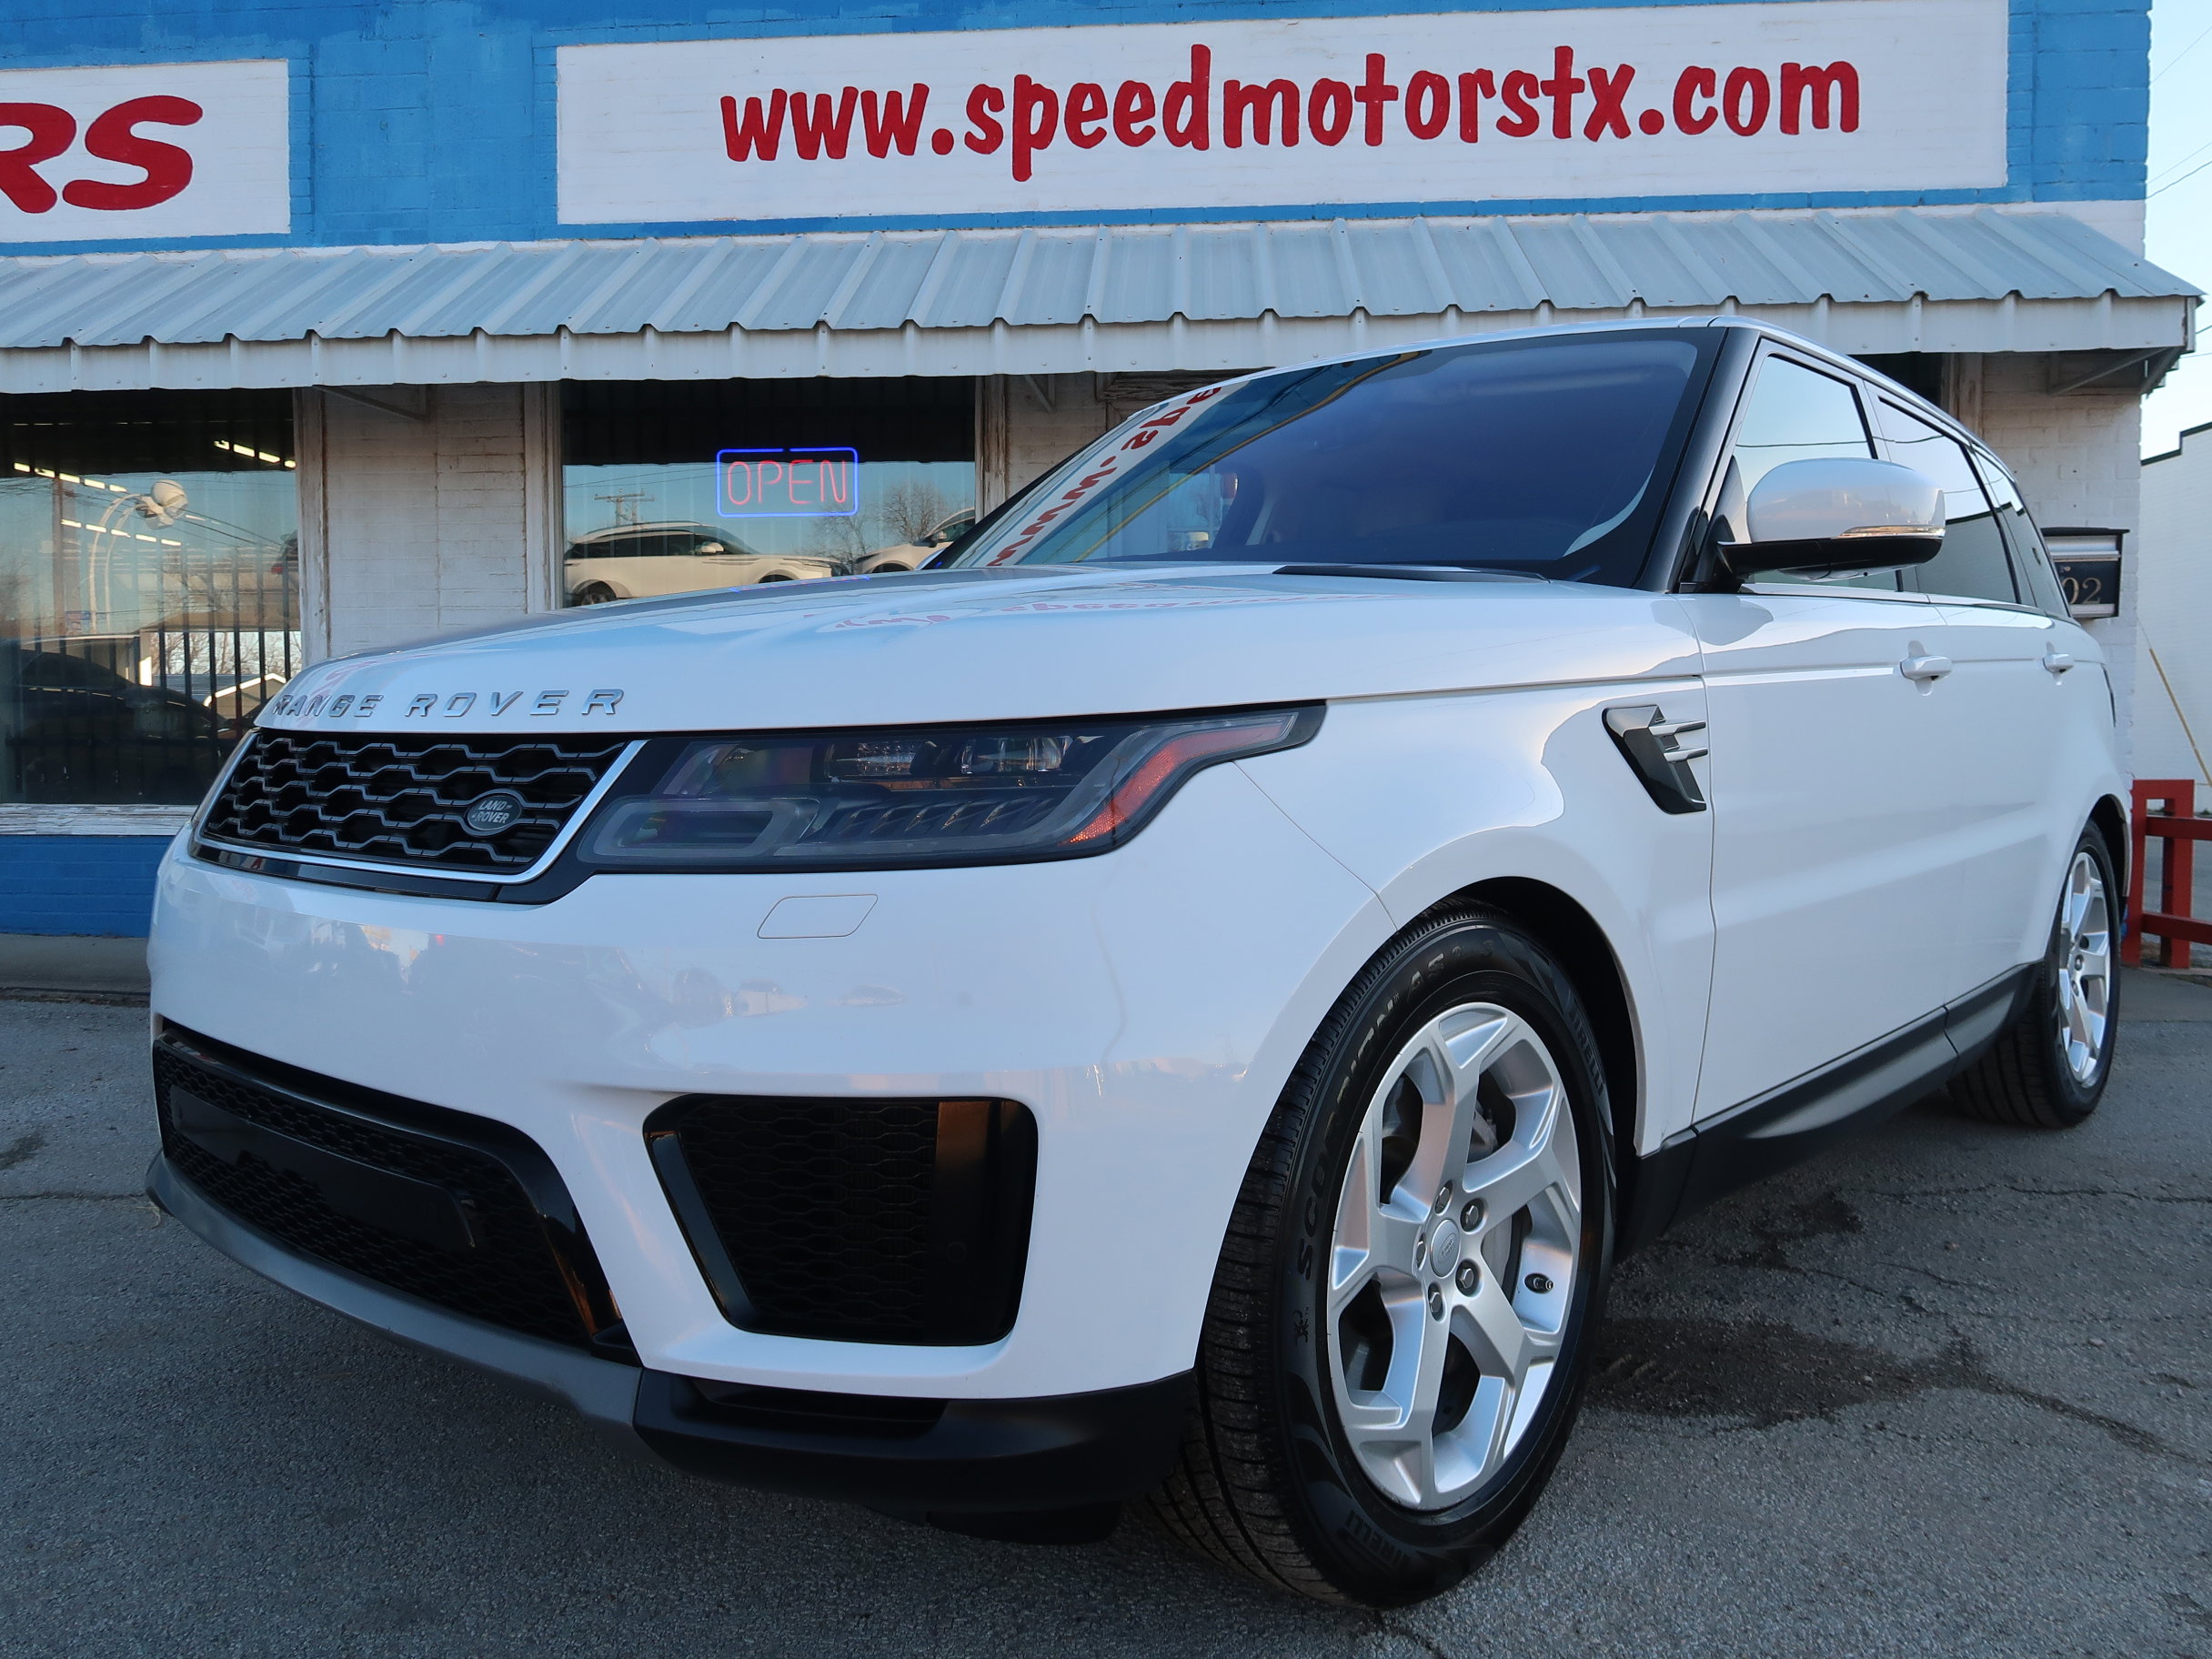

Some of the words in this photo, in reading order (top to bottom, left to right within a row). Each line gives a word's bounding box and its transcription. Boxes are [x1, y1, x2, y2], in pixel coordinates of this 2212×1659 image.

[720, 44, 1859, 182] www.speedmotorstx.com
[0, 96, 204, 214] RS
[727, 459, 847, 506] OPEN
[272, 694, 385, 718] RANGE
[404, 689, 625, 718] ROVER
[474, 810, 510, 823] ROVER
[478, 800, 508, 811] LAND
